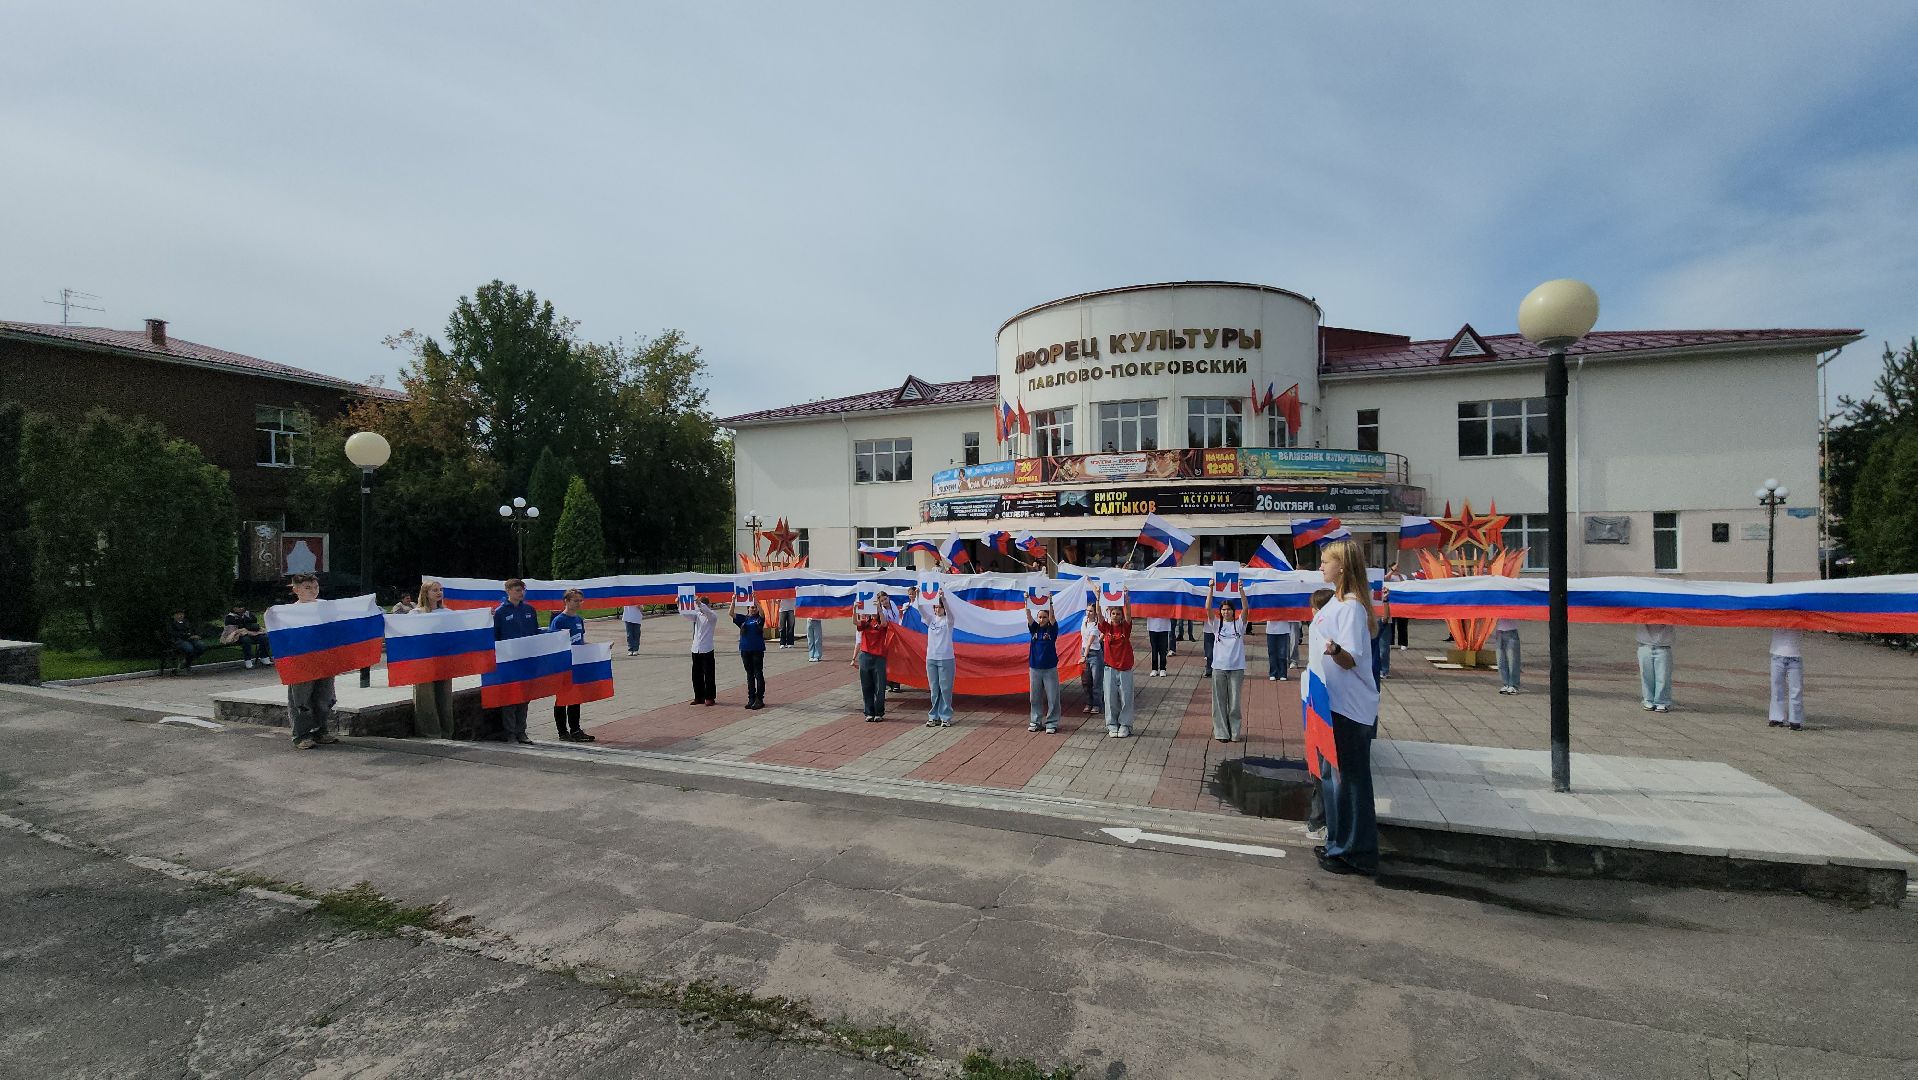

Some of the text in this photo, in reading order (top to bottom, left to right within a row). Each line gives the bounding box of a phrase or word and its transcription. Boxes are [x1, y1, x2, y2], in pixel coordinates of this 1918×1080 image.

[1014, 328, 1262, 374] ДВОРЕЦ КУЛЬТУРЫ
[1028, 357, 1247, 391] ПАВЛОВО-ПОКРОВСКИЙ
[1205, 453, 1235, 461] НАЧАЛО
[1207, 463, 1235, 474] 12:00
[1094, 491, 1128, 502] ВИКТОР
[1183, 495, 1230, 503] ИСТОРИЯ
[1001, 500, 1010, 510] 17
[1094, 500, 1157, 515] САЛТЫКОВ
[1255, 494, 1272, 511] 26
[1273, 501, 1314, 511] ОКТЯБРЯ
[1001, 510, 1029, 518] ОКТЯБРЯ
[1215, 571, 1239, 593] И
